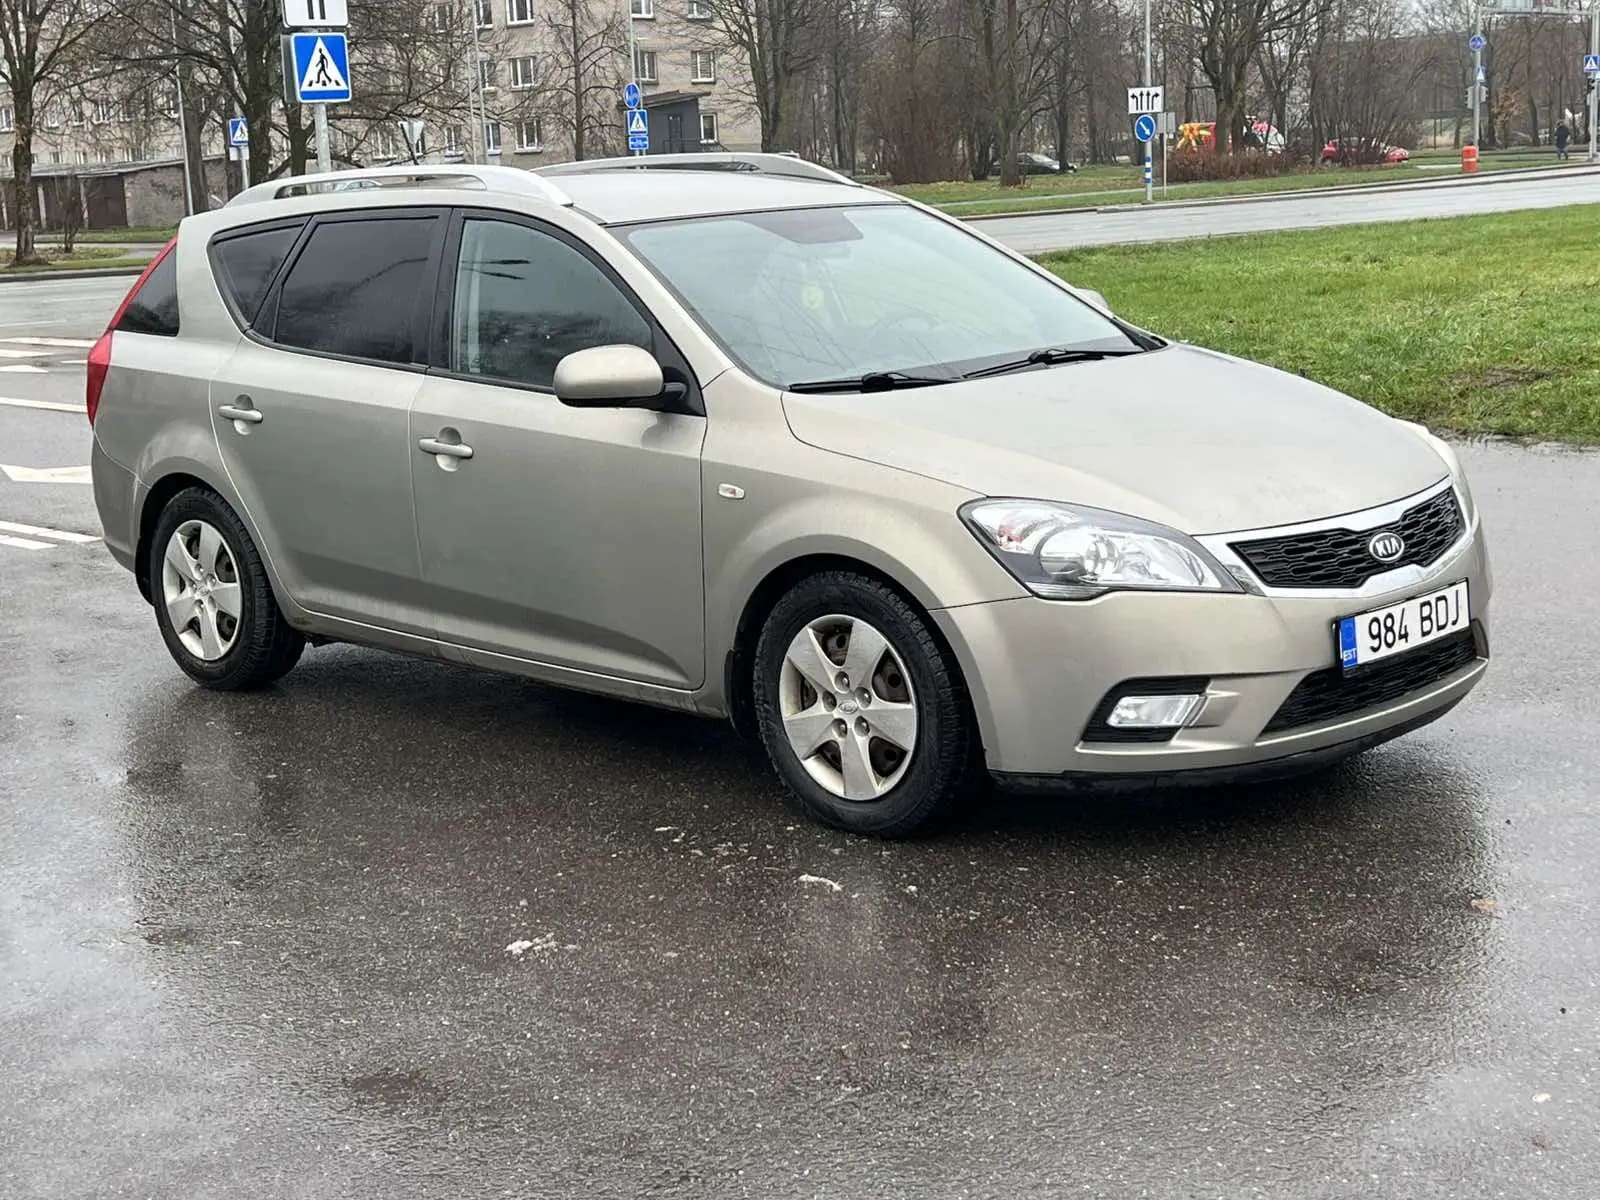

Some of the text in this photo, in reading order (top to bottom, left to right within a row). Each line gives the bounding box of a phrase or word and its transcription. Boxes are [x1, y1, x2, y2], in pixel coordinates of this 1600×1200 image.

[1375, 537, 1400, 556] KIA
[1368, 589, 1459, 653] 984 BDJ
